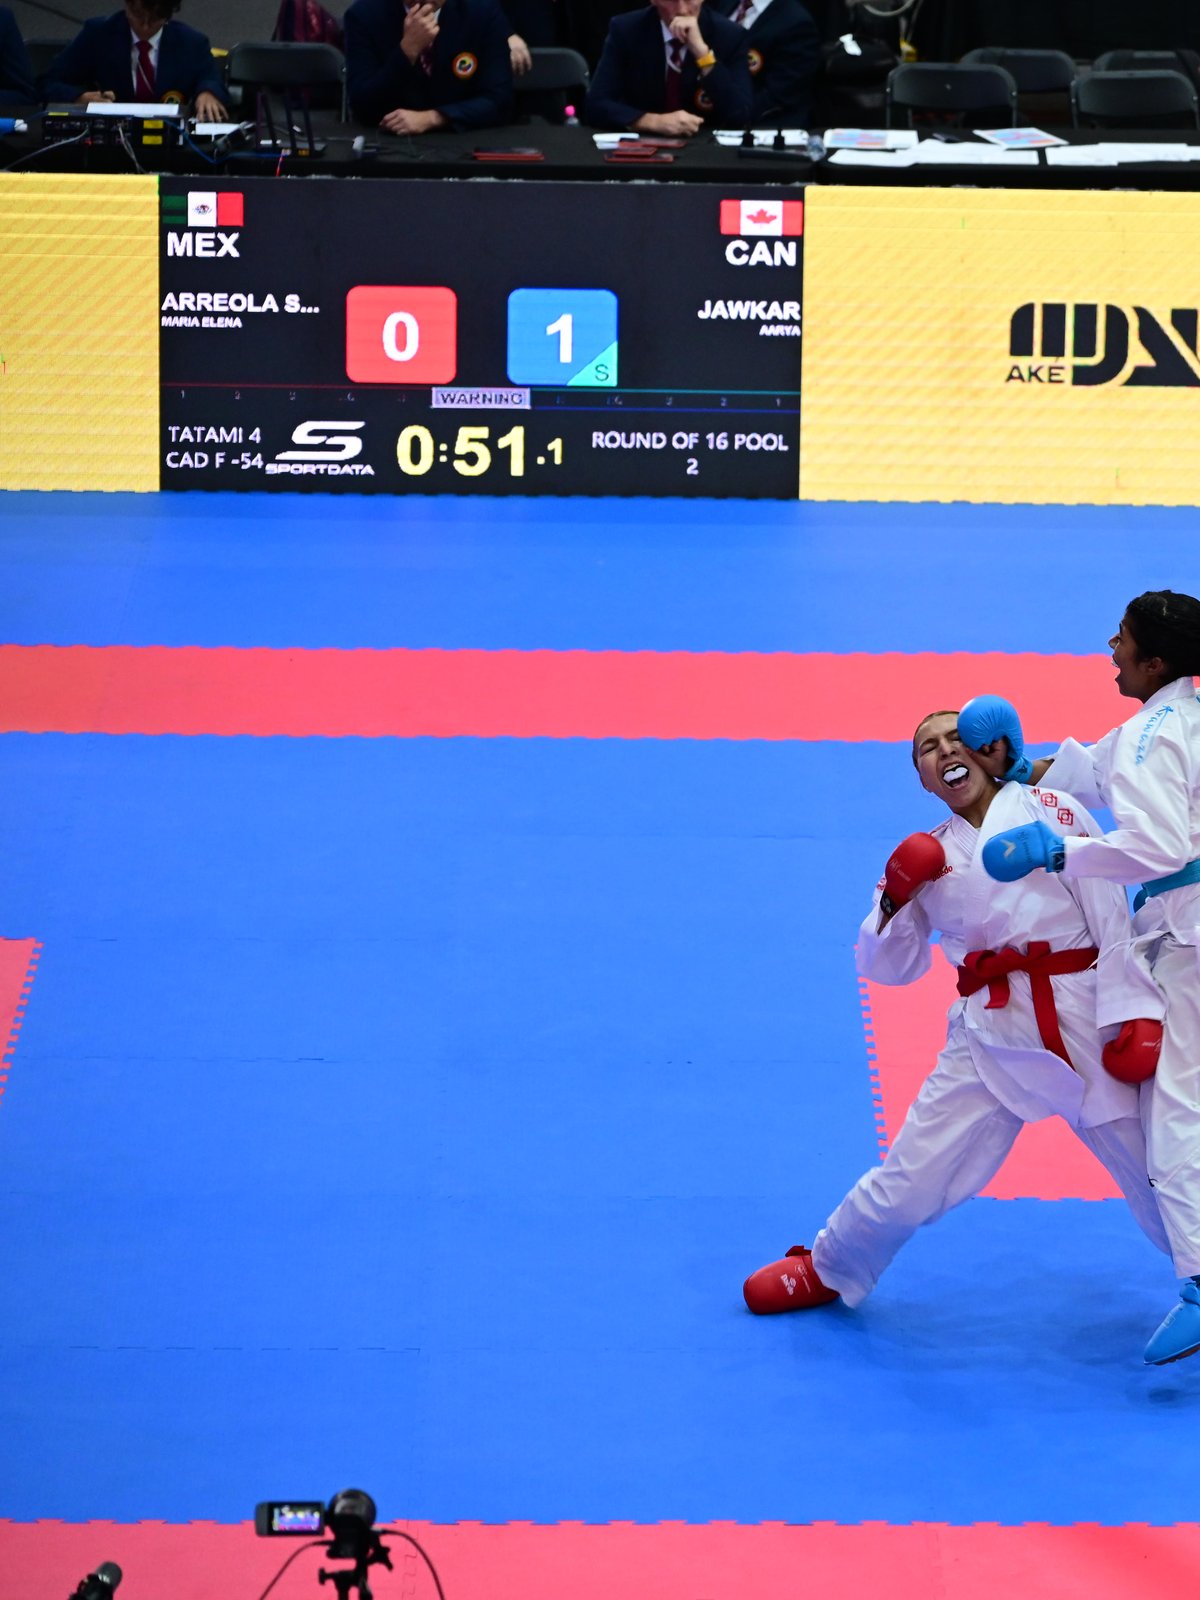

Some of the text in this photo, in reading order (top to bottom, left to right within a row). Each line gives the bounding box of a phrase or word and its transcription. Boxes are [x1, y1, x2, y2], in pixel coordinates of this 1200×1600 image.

[167, 232, 240, 257] MEX
[725, 240, 797, 266] CAN
[161, 292, 320, 313] ARREOLA S...
[697, 300, 800, 320] JAWKAR
[161, 316, 242, 328] MARIA ELENA
[759, 325, 801, 336] AARYA
[382, 311, 419, 361] 0
[546, 313, 573, 363] 1
[594, 363, 610, 382] S
[440, 390, 523, 405] WARNING
[168, 426, 262, 443] TATAMI 4
[592, 431, 788, 450] ROUND OF 16 POOL
[166, 452, 263, 469] CAD F -54
[265, 463, 375, 476] SPORTDATA
[686, 458, 699, 475] 2
